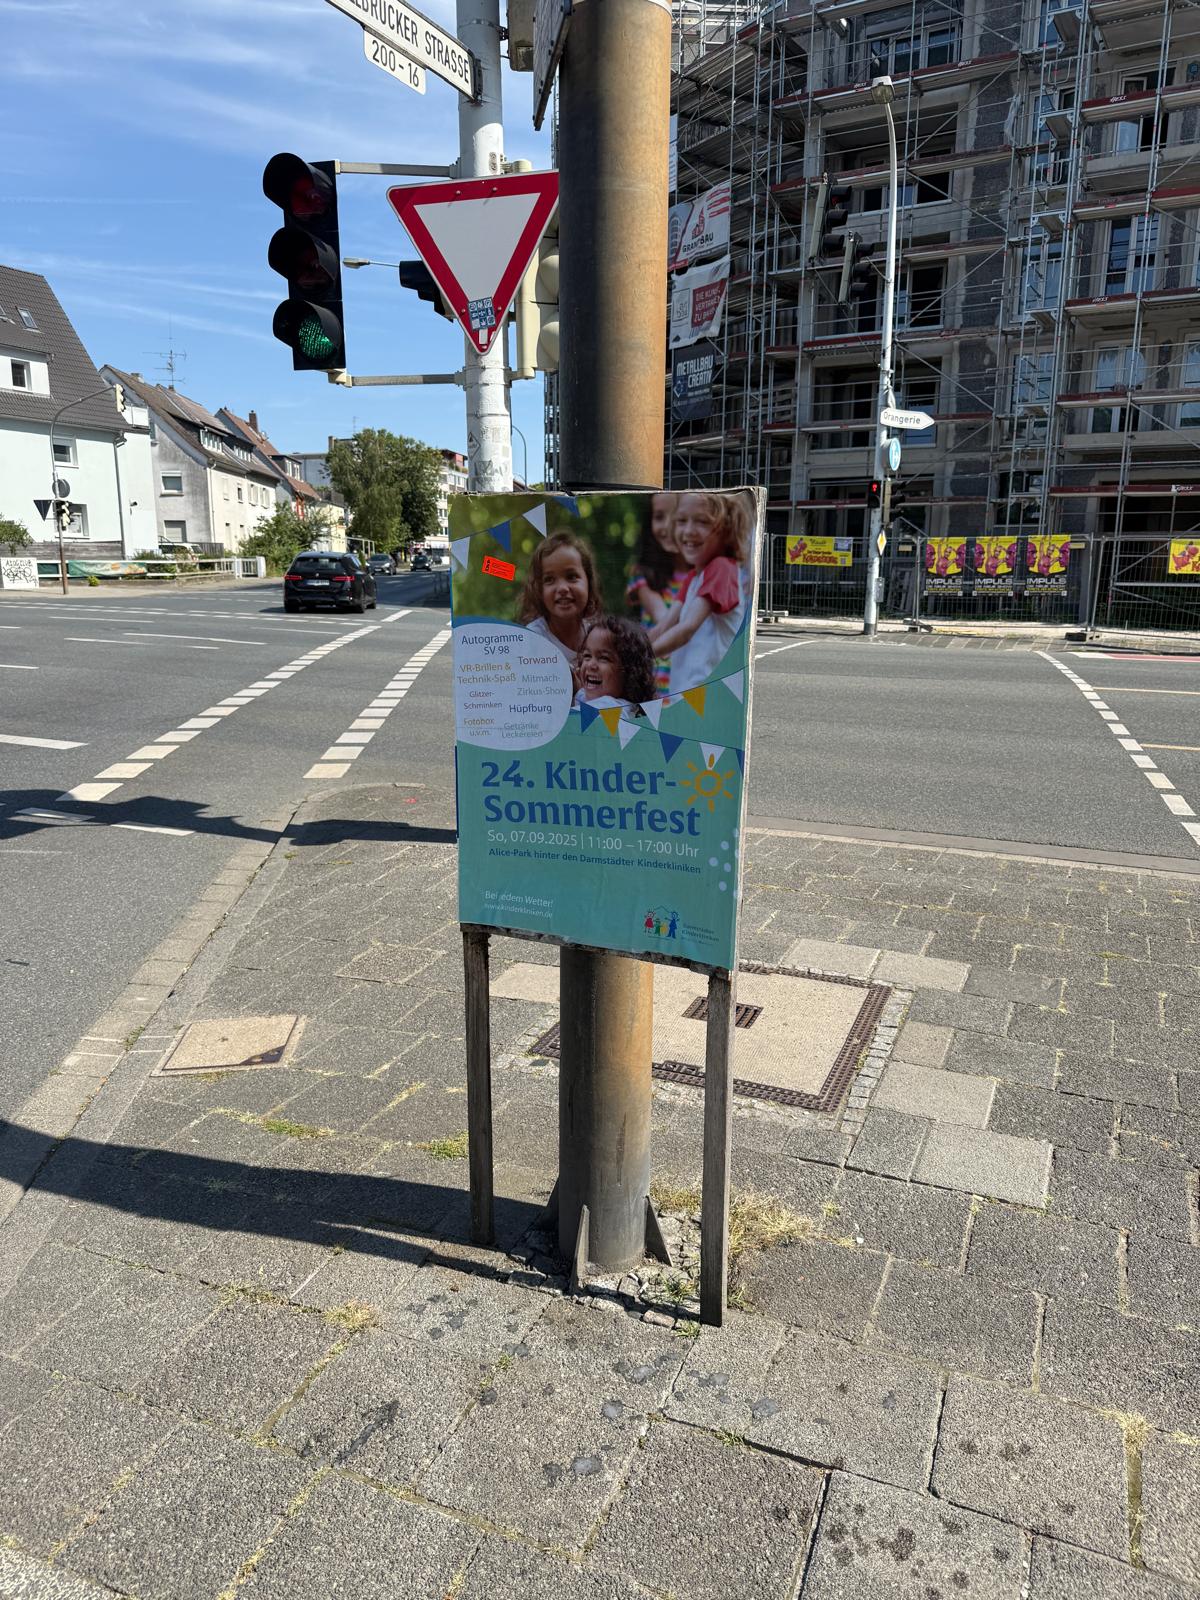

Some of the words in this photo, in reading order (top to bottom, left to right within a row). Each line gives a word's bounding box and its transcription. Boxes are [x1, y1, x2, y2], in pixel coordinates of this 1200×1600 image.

[424, 30, 469, 84] STRASSE
[676, 354, 714, 377] METALLBAU
[883, 411, 921, 424] Orangerie
[926, 577, 962, 585] IMPULS
[975, 577, 1013, 585] IMPULS
[1026, 577, 1067, 585] IMPULS
[461, 634, 524, 645] Autogramme
[484, 646, 496, 655] SV
[498, 646, 510, 655] 98
[517, 655, 558, 665] Torwand
[459, 663, 503, 672] VR-Brillen
[505, 662, 512, 671] &
[457, 673, 517, 684] Technik-Spaß
[522, 675, 561, 683] Mitmach-
[469, 690, 495, 698] Glitzer-
[517, 687, 568, 696] Zirkus-Show
[463, 701, 503, 710] Schminken
[509, 703, 553, 715] Hüpfburg
[463, 718, 495, 726] Fotobox
[481, 759, 535, 788] 24.
[545, 760, 677, 795] Kinder-
[484, 794, 701, 837] Sommerfest
[487, 829, 508, 844] So,
[510, 830, 578, 846] 07.09.2025
[589, 836, 622, 850] 11:00
[637, 839, 672, 854] 17:00
[675, 843, 700, 858] Uhr
[488, 848, 533, 858] Alice-Park
[534, 850, 560, 860] hinter
[562, 852, 578, 861] den
[580, 854, 634, 866] Darmstädter
[637, 858, 702, 874] Kinderkliniken
[485, 890, 498, 900] Bei
